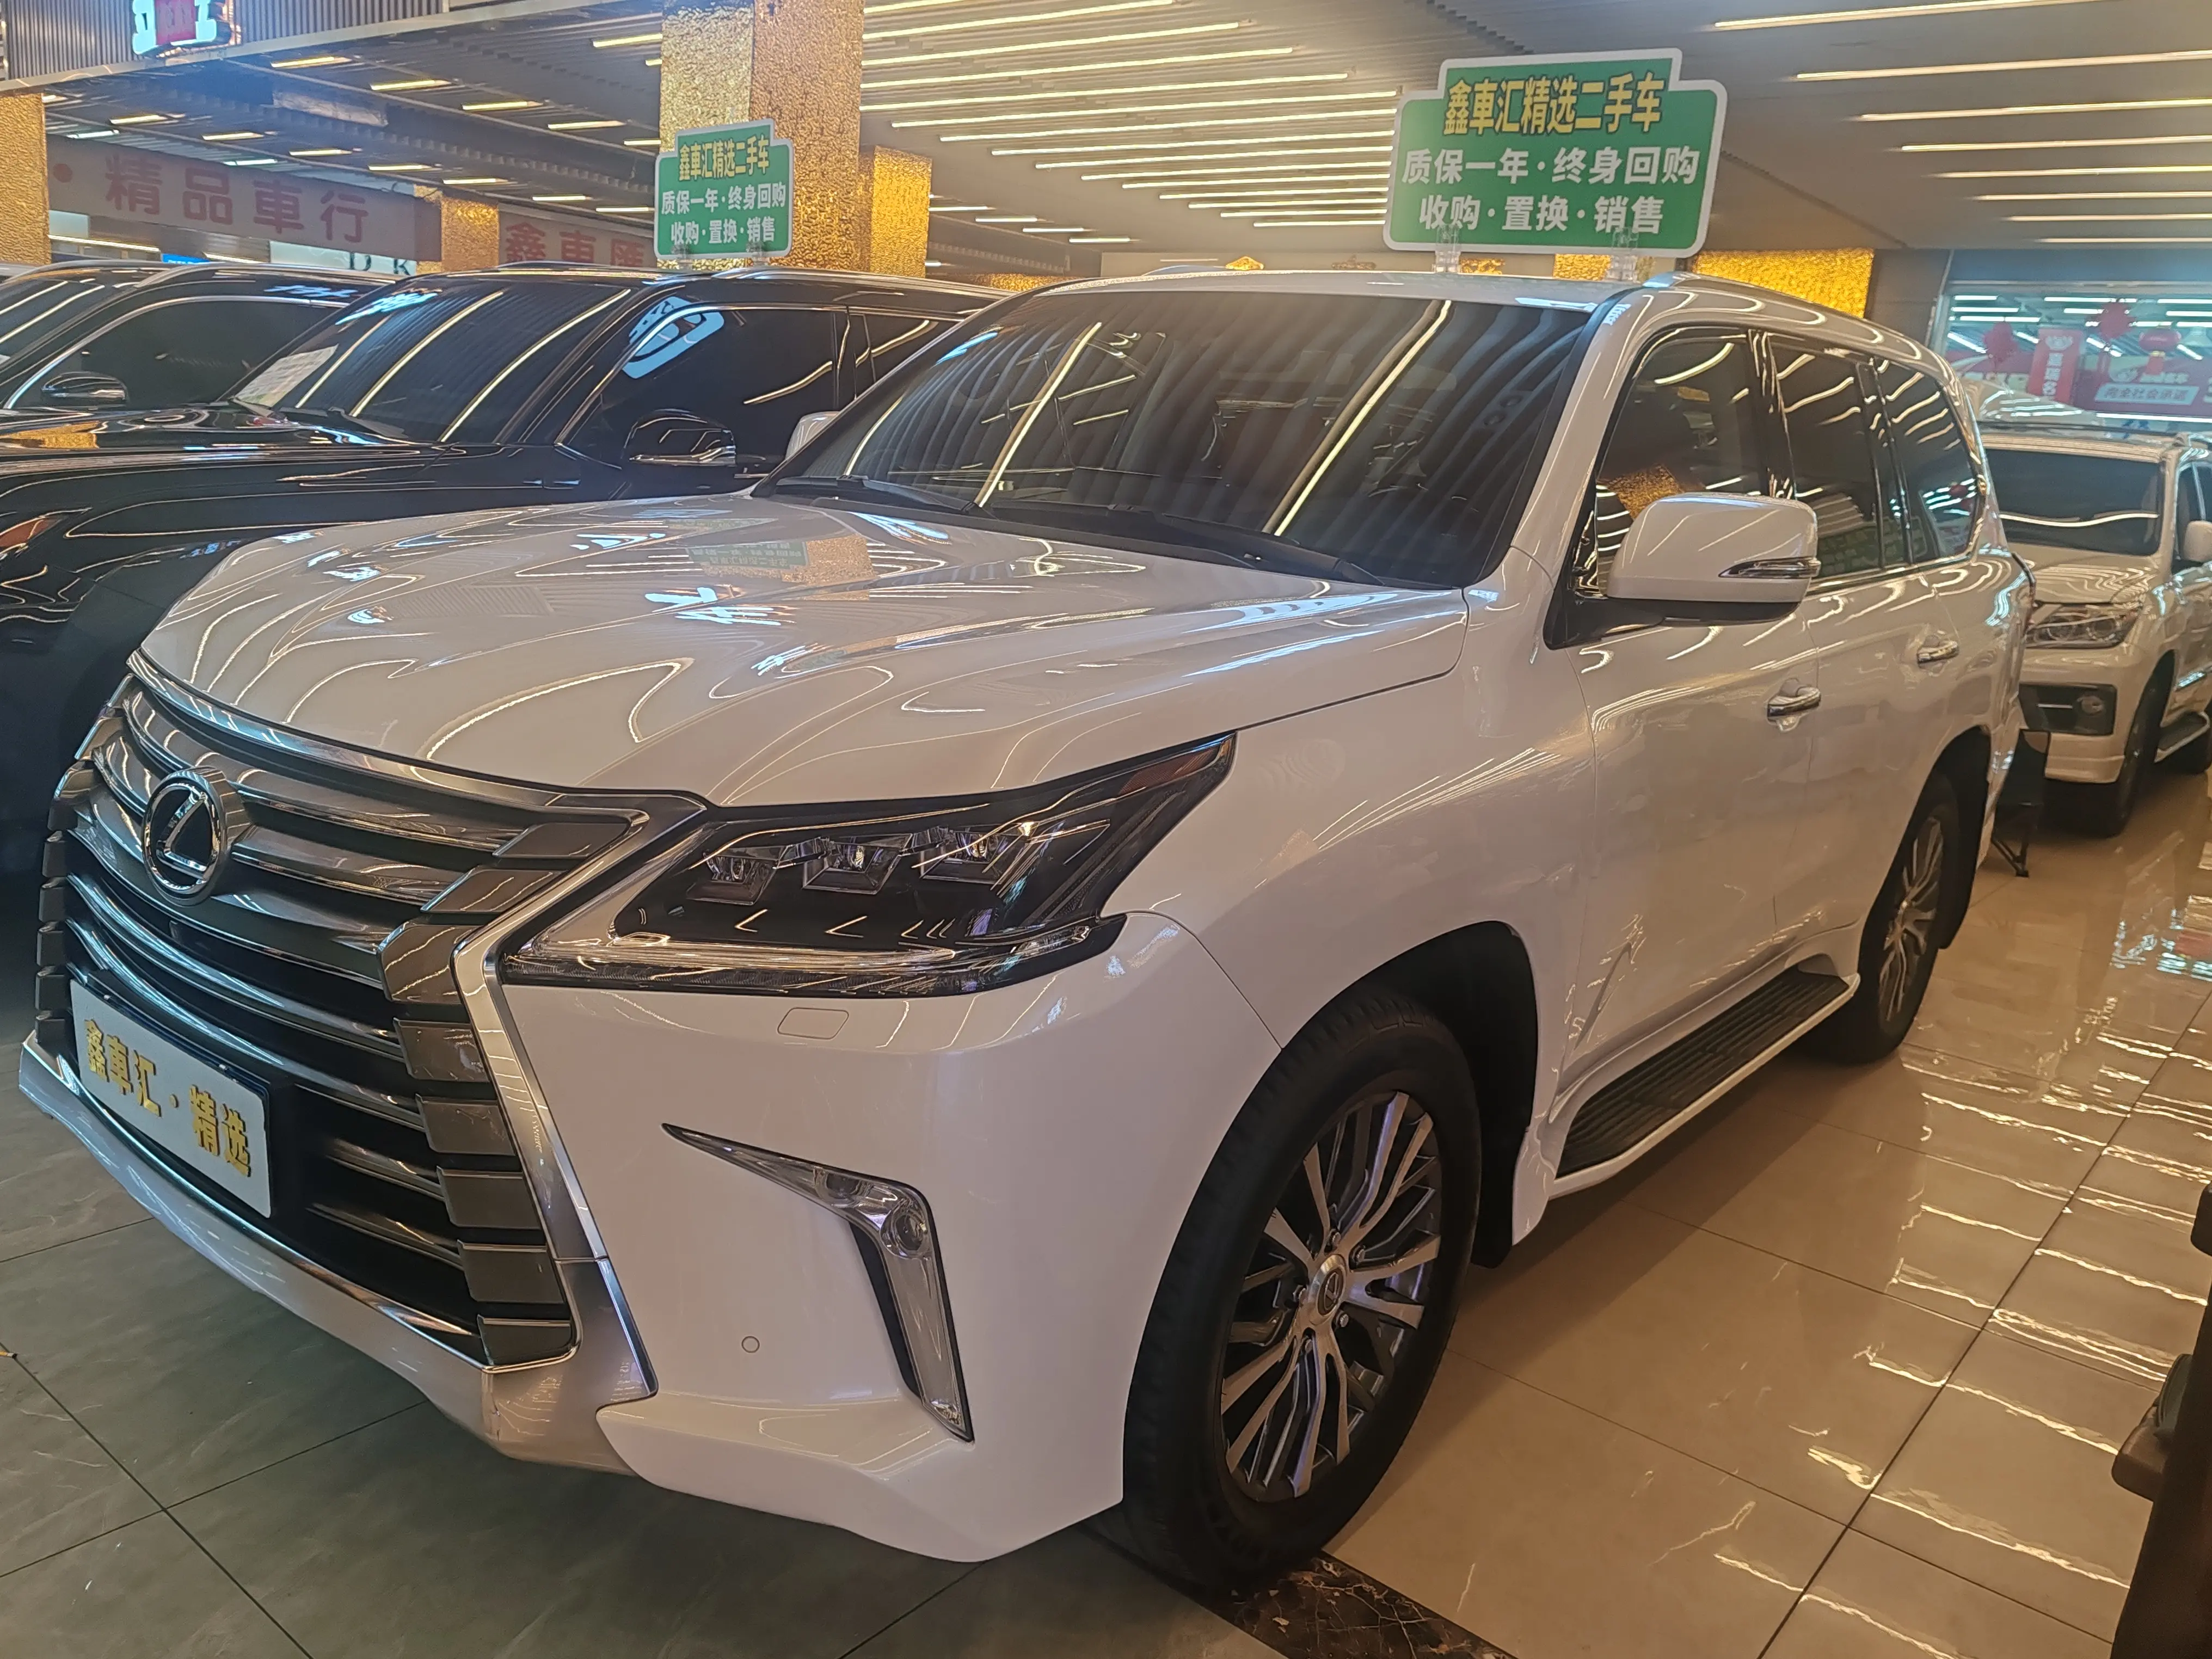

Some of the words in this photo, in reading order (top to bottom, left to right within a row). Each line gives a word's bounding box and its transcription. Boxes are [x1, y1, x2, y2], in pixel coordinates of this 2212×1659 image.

[1443, 72, 1666, 135] 鑫車汇精选二手车
[679, 134, 769, 181] 鑫車汇精选二手车
[1401, 146, 1700, 185] 质保一年·终身回购
[661, 181, 787, 214] 质保一年·终身回购
[1419, 194, 1665, 235] 收购·置换·销售
[671, 216, 775, 245] 收购·置换·销售
[84, 1018, 251, 1177] 鑫車汇·精选
